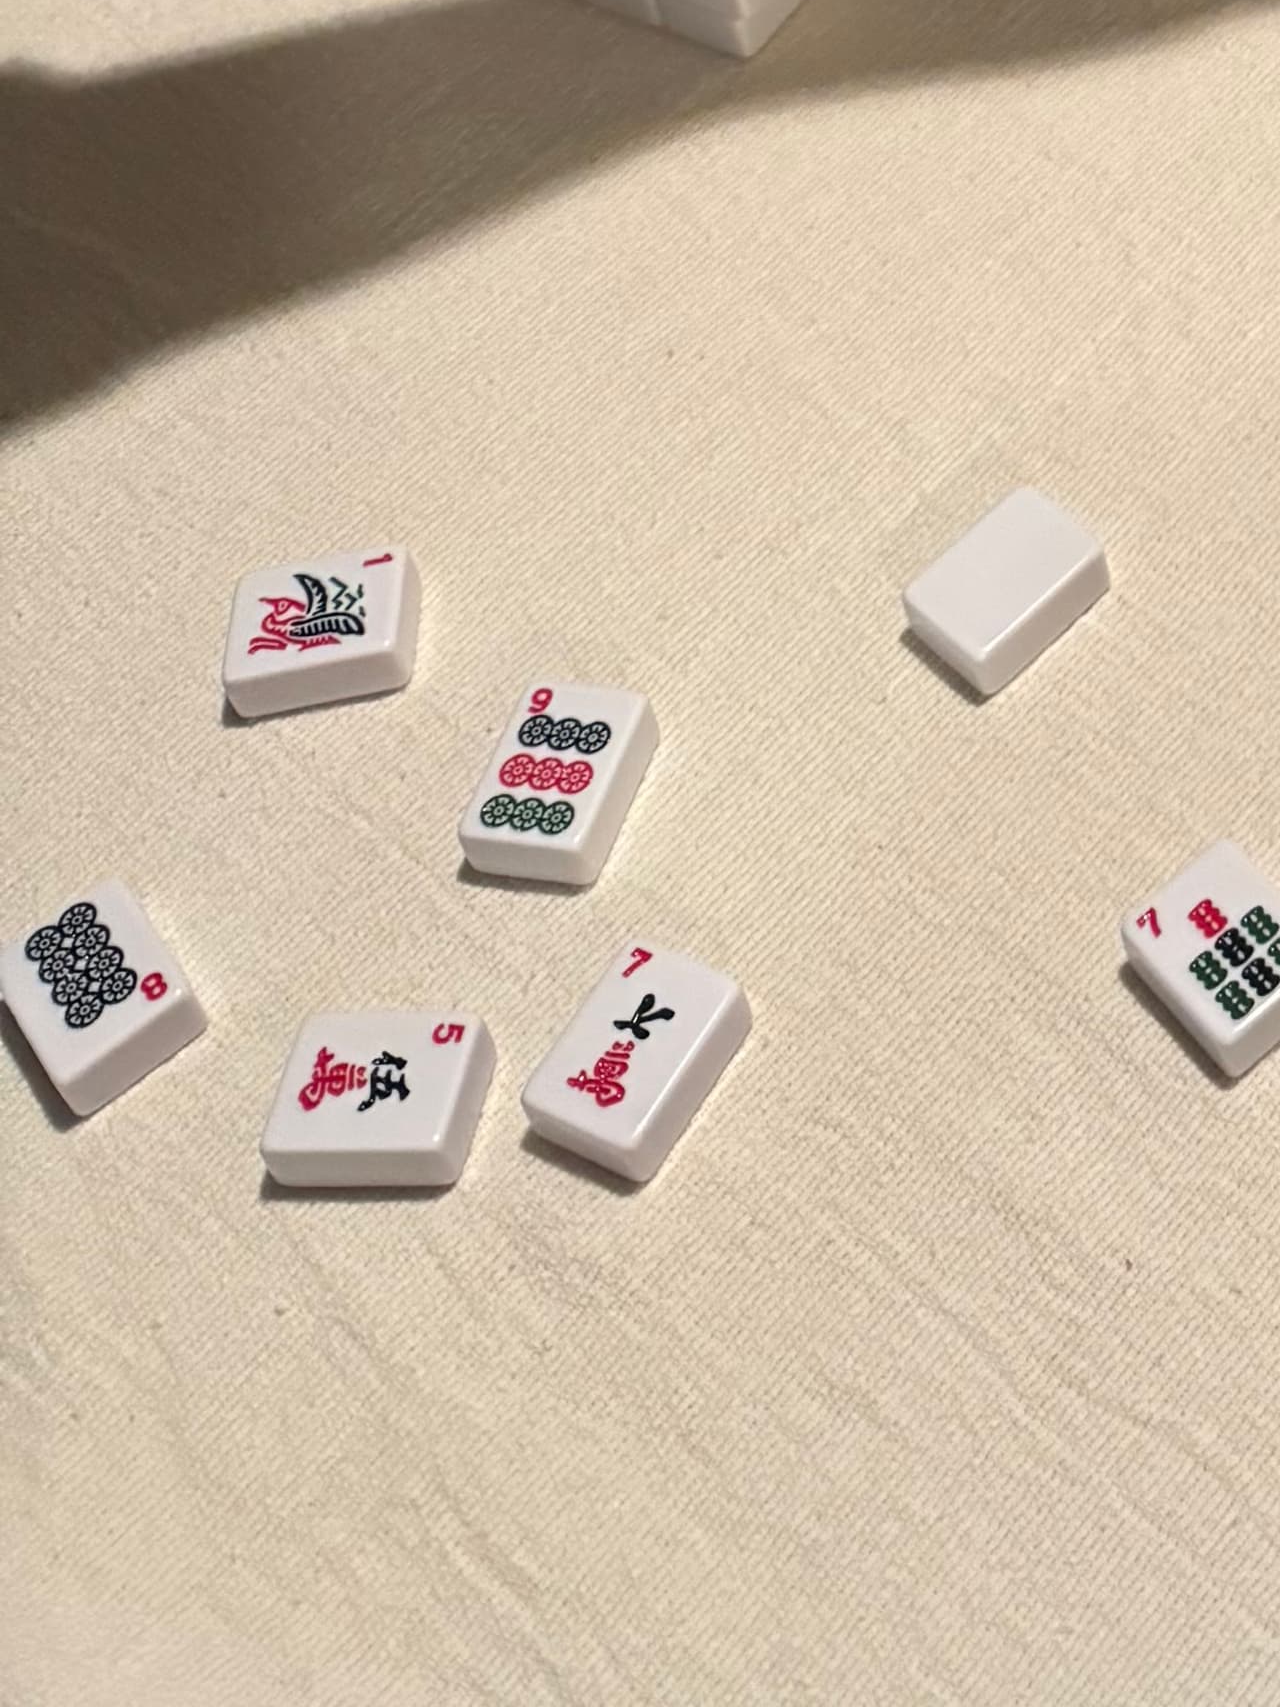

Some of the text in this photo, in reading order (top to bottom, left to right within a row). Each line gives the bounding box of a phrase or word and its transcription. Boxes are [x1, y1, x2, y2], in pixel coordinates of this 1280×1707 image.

[363, 553, 393, 567] 1
[527, 687, 553, 718] 9
[1135, 907, 1162, 938] 7
[622, 947, 653, 978] 7
[139, 971, 169, 1002] 8
[431, 1023, 465, 1046] 5
